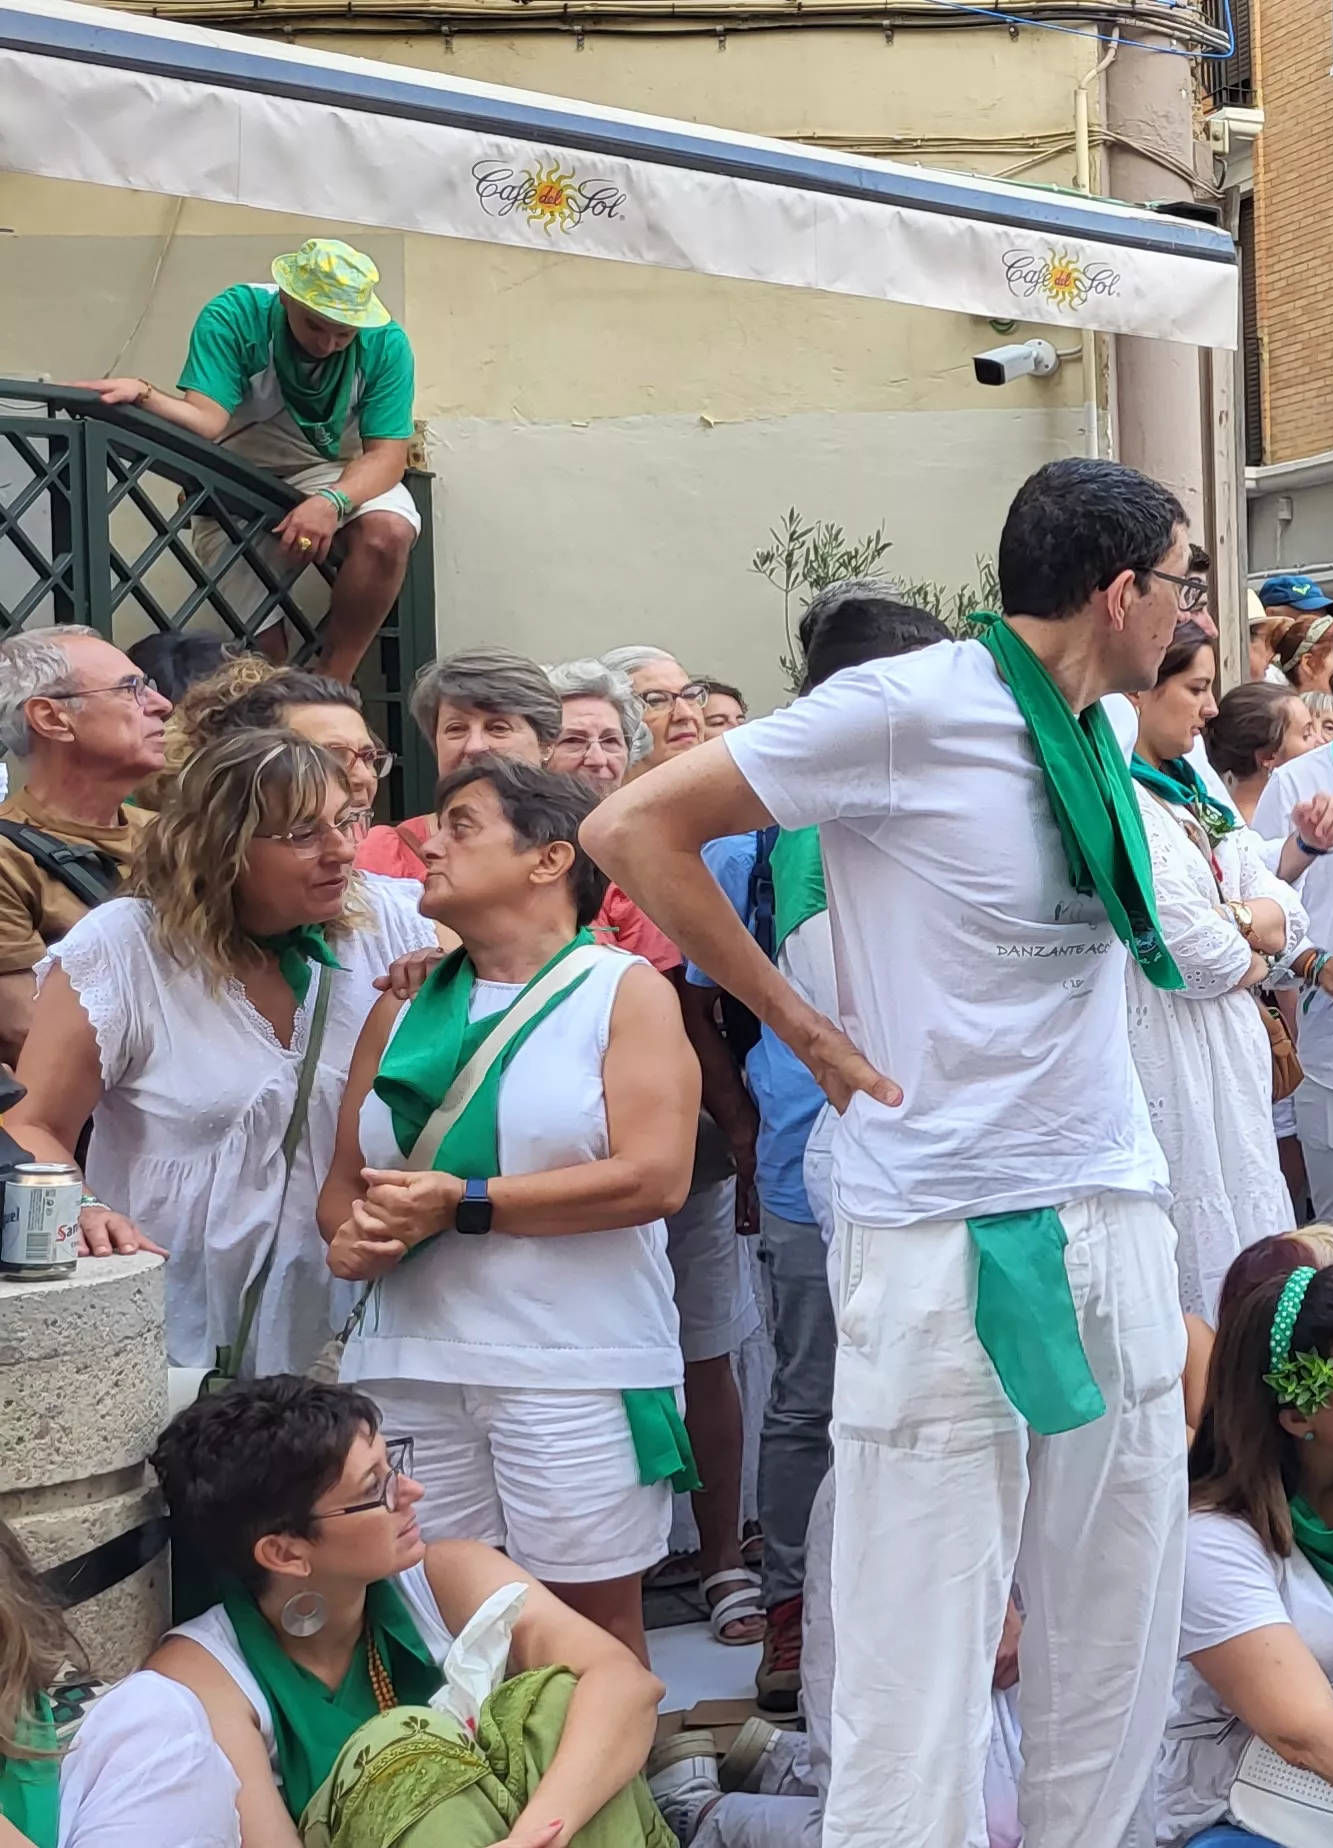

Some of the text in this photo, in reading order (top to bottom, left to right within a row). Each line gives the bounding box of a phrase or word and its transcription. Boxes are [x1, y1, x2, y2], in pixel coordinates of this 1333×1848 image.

[538, 184, 563, 206] del
[566, 179, 627, 230] Sol
[1054, 270, 1072, 287] del
[1074, 262, 1120, 306] Sol
[997, 943, 1085, 958] DANZANTE
[55, 1223, 79, 1243] San
